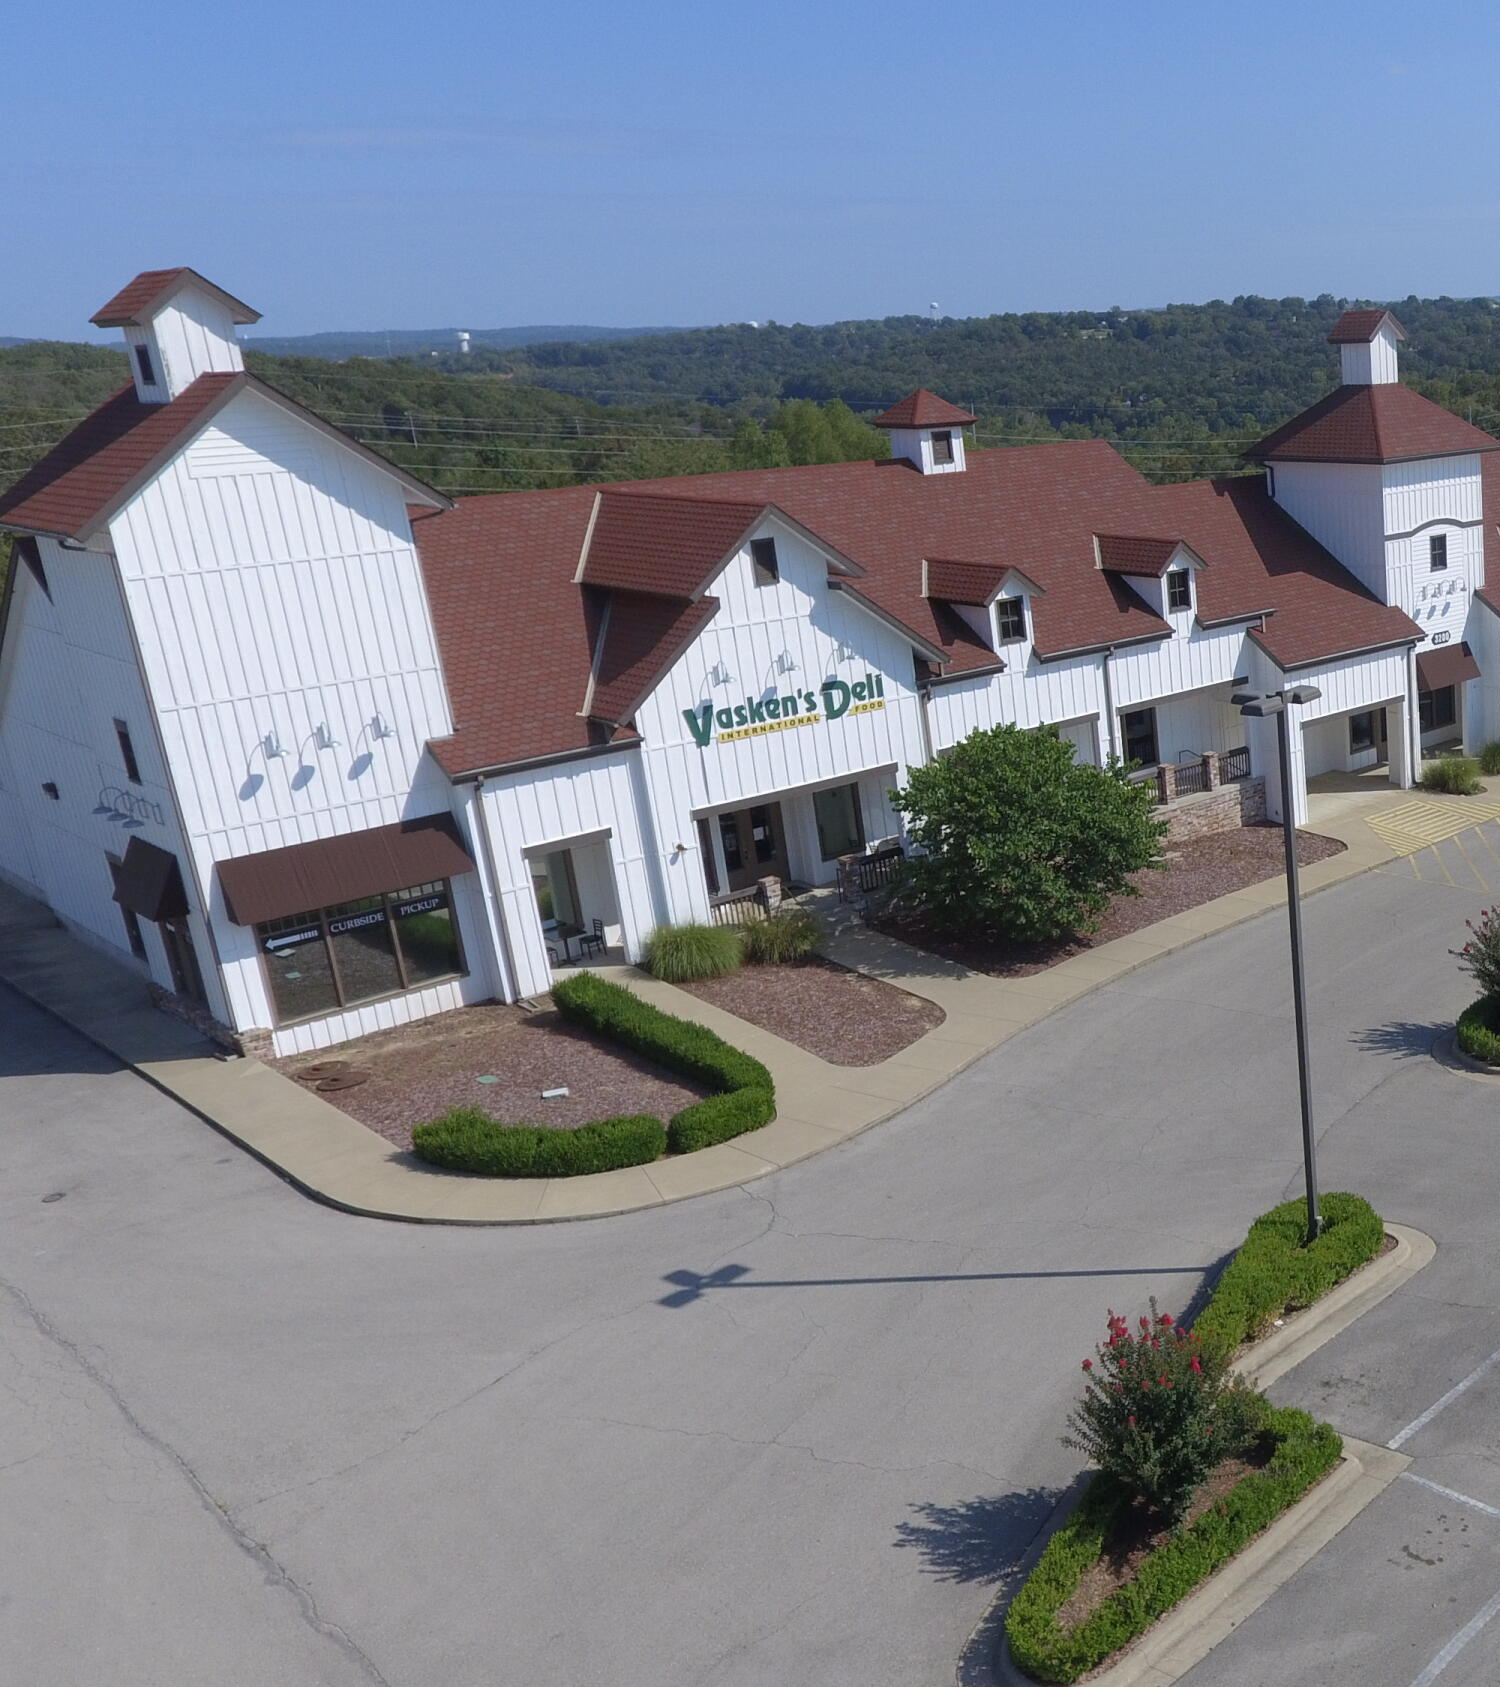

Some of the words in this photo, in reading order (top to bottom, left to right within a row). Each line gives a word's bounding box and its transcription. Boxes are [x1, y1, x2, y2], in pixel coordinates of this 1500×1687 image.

[682, 688, 817, 748] Vasken's
[821, 673, 884, 720] Deli
[721, 714, 820, 741] INTERNATIONAL
[855, 700, 884, 713] FOOD
[330, 912, 385, 933] CURBSIDE
[400, 898, 439, 916] PICKUP
